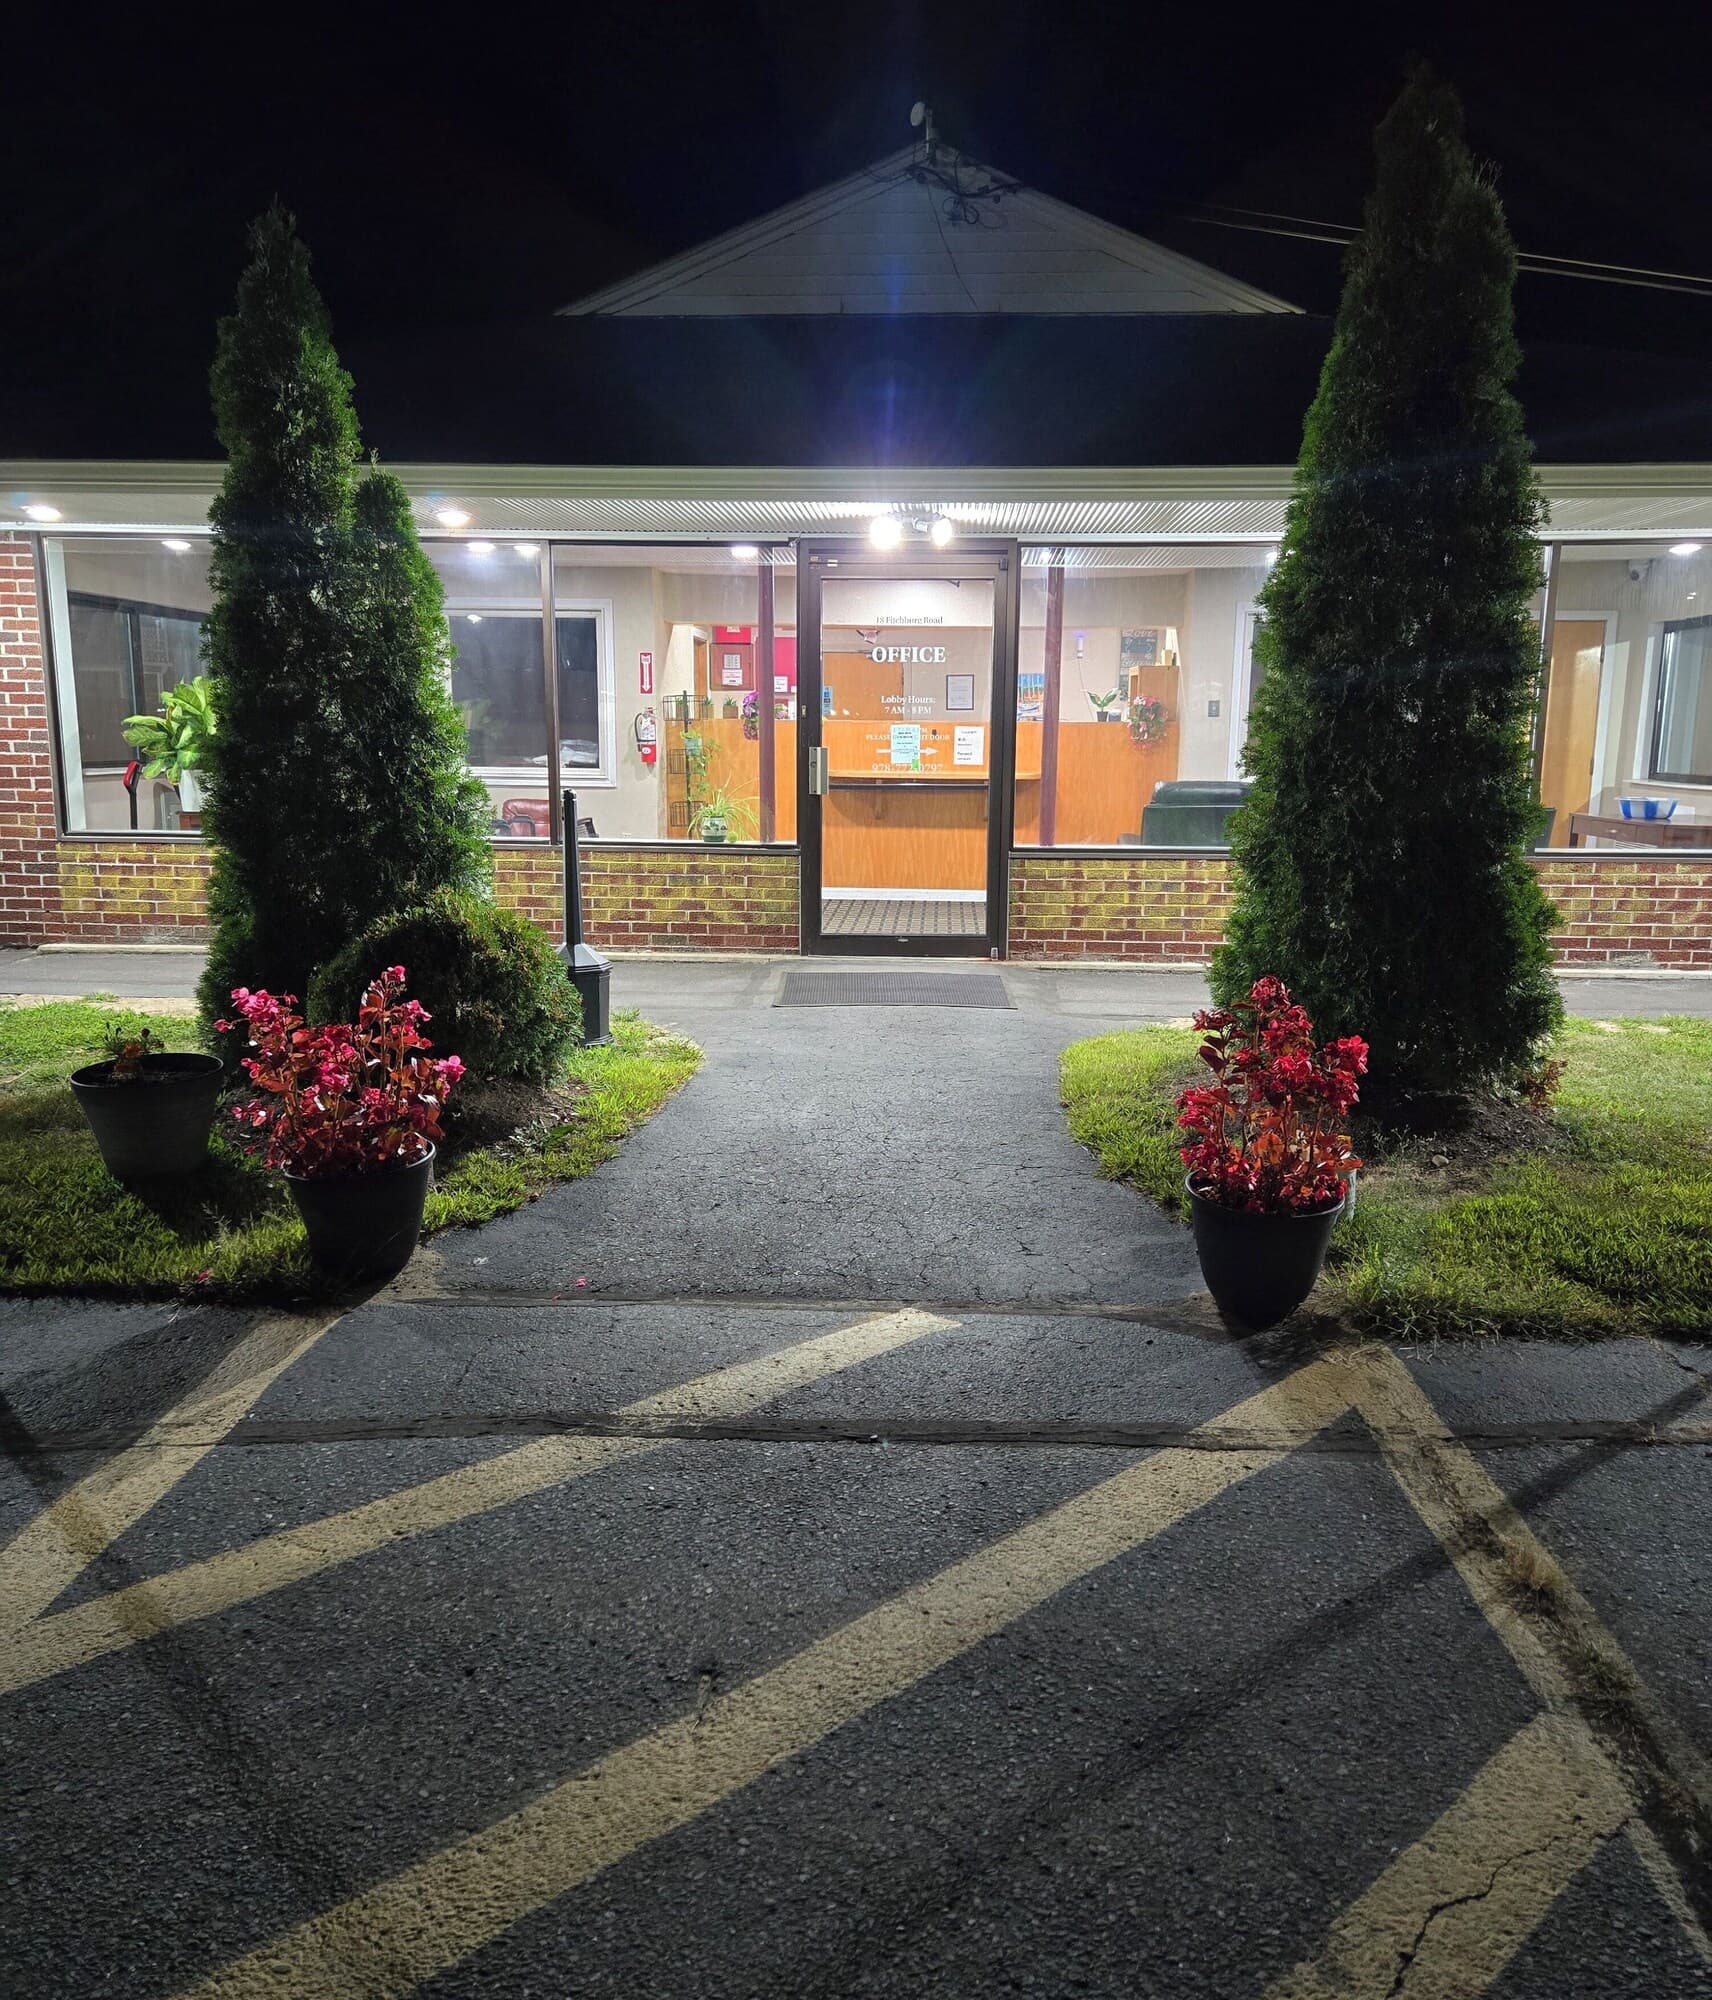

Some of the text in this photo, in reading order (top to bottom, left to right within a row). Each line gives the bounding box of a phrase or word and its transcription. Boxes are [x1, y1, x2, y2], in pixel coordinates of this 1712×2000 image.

[924, 616, 943, 625] Road
[872, 647, 946, 662] OFFICE
[881, 695, 936, 705] Lobby Hours:
[891, 706, 905, 714] AM
